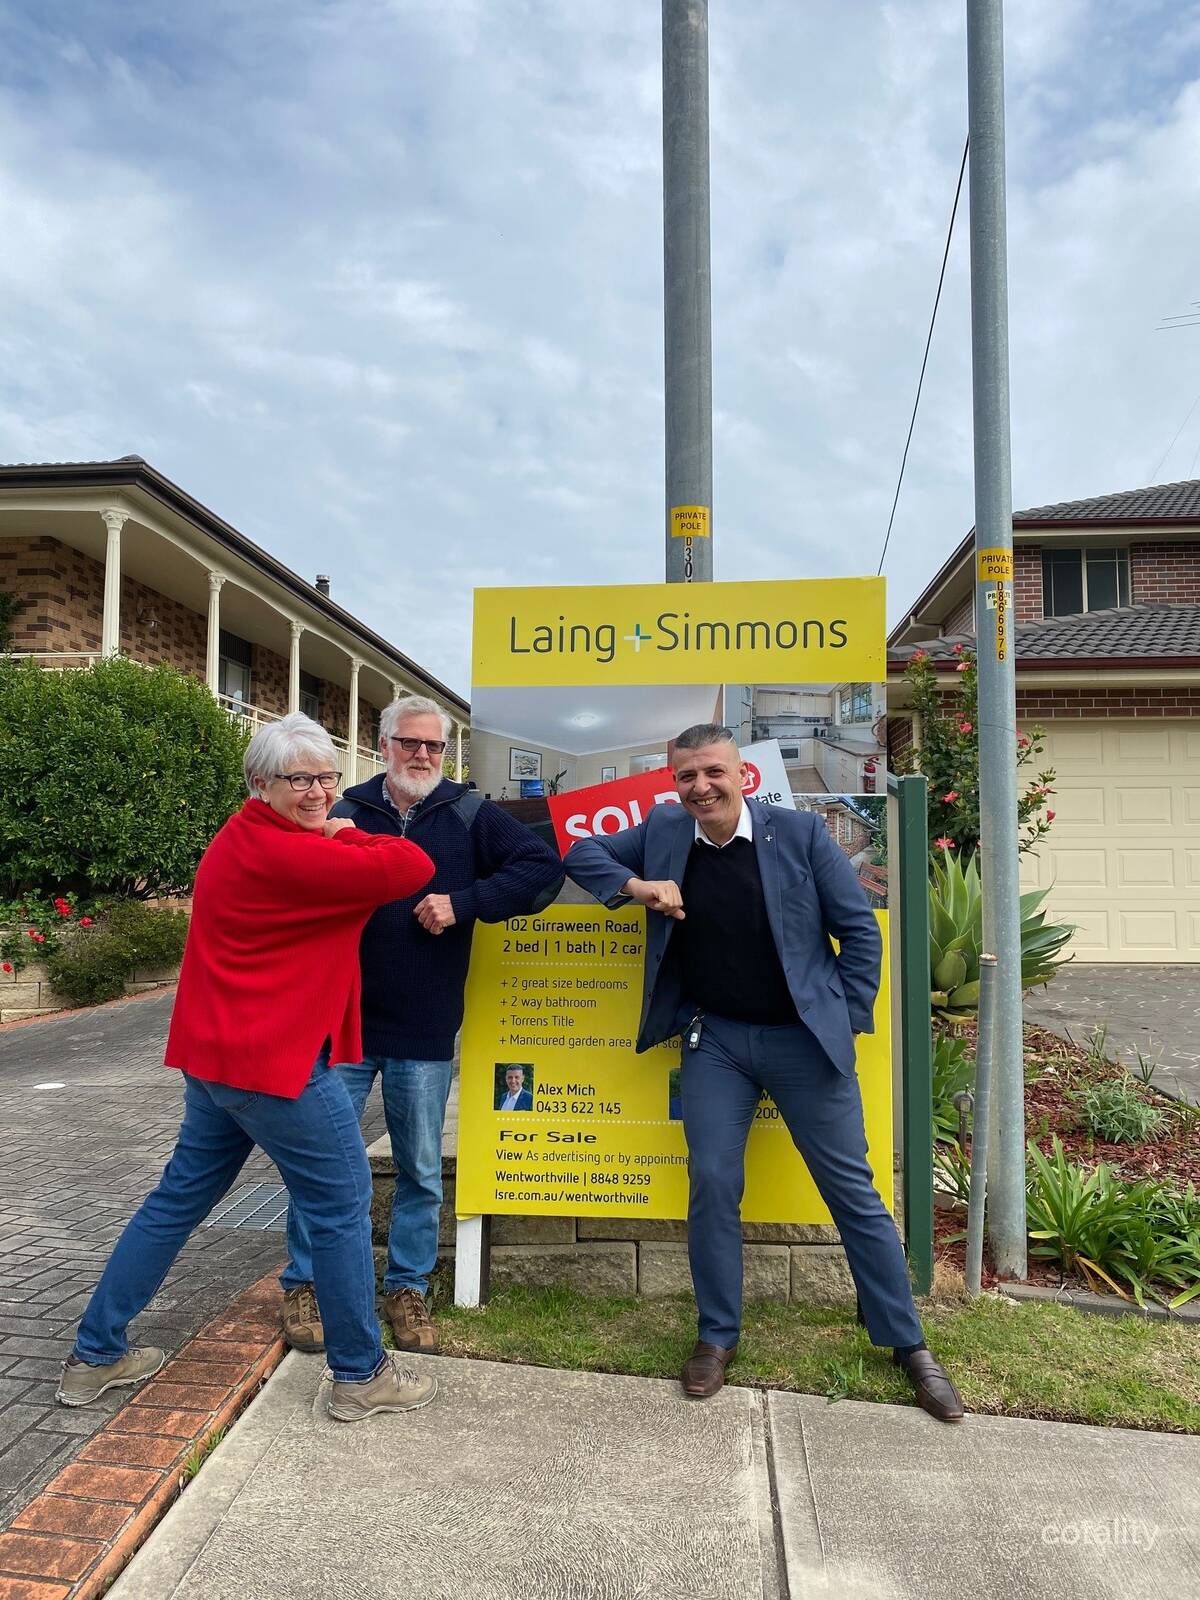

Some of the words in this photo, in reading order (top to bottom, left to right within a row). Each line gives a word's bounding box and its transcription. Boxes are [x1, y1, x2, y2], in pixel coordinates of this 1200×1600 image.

[675, 511, 707, 520] PRIVATE
[680, 522, 702, 530] POLE
[684, 536, 693, 583] D30
[981, 555, 1013, 563] PRIVATE
[988, 566, 1010, 574] POLE
[510, 615, 616, 663] Laing
[656, 612, 848, 651] Simmons
[503, 919, 527, 932] 102
[532, 919, 601, 933] Girraween
[605, 919, 642, 935] Road,
[503, 940, 511, 953] 2
[516, 940, 540, 953] bed
[554, 940, 561, 953] 1
[567, 941, 596, 954] bath
[610, 941, 618, 954] 2
[622, 943, 643, 955] car
[511, 978, 518, 988] 2
[521, 978, 549, 991] great
[552, 978, 573, 989] size
[576, 978, 628, 990] bedrooms
[511, 996, 518, 1007] 2
[521, 998, 542, 1010] way
[546, 997, 597, 1008] bathroom
[510, 1015, 548, 1026] Torrens
[552, 1015, 575, 1027] Title
[510, 1034, 565, 1046] Manicured
[569, 1035, 605, 1049] garden
[608, 1038, 632, 1048] area
[536, 1083, 563, 1096] Alex
[567, 1083, 596, 1096] Mich
[536, 1101, 567, 1113] 0433
[571, 1101, 594, 1114] 622
[598, 1102, 621, 1115] 145
[500, 1130, 539, 1142] For
[546, 1131, 598, 1143] Sale
[496, 1150, 523, 1161] View
[526, 1150, 540, 1162] As
[542, 1150, 600, 1165] advertising
[604, 1153, 615, 1164] or
[618, 1152, 631, 1166] by
[495, 1171, 580, 1184] Wentworthville
[590, 1172, 619, 1185] 8848
[622, 1173, 651, 1186] 9259
